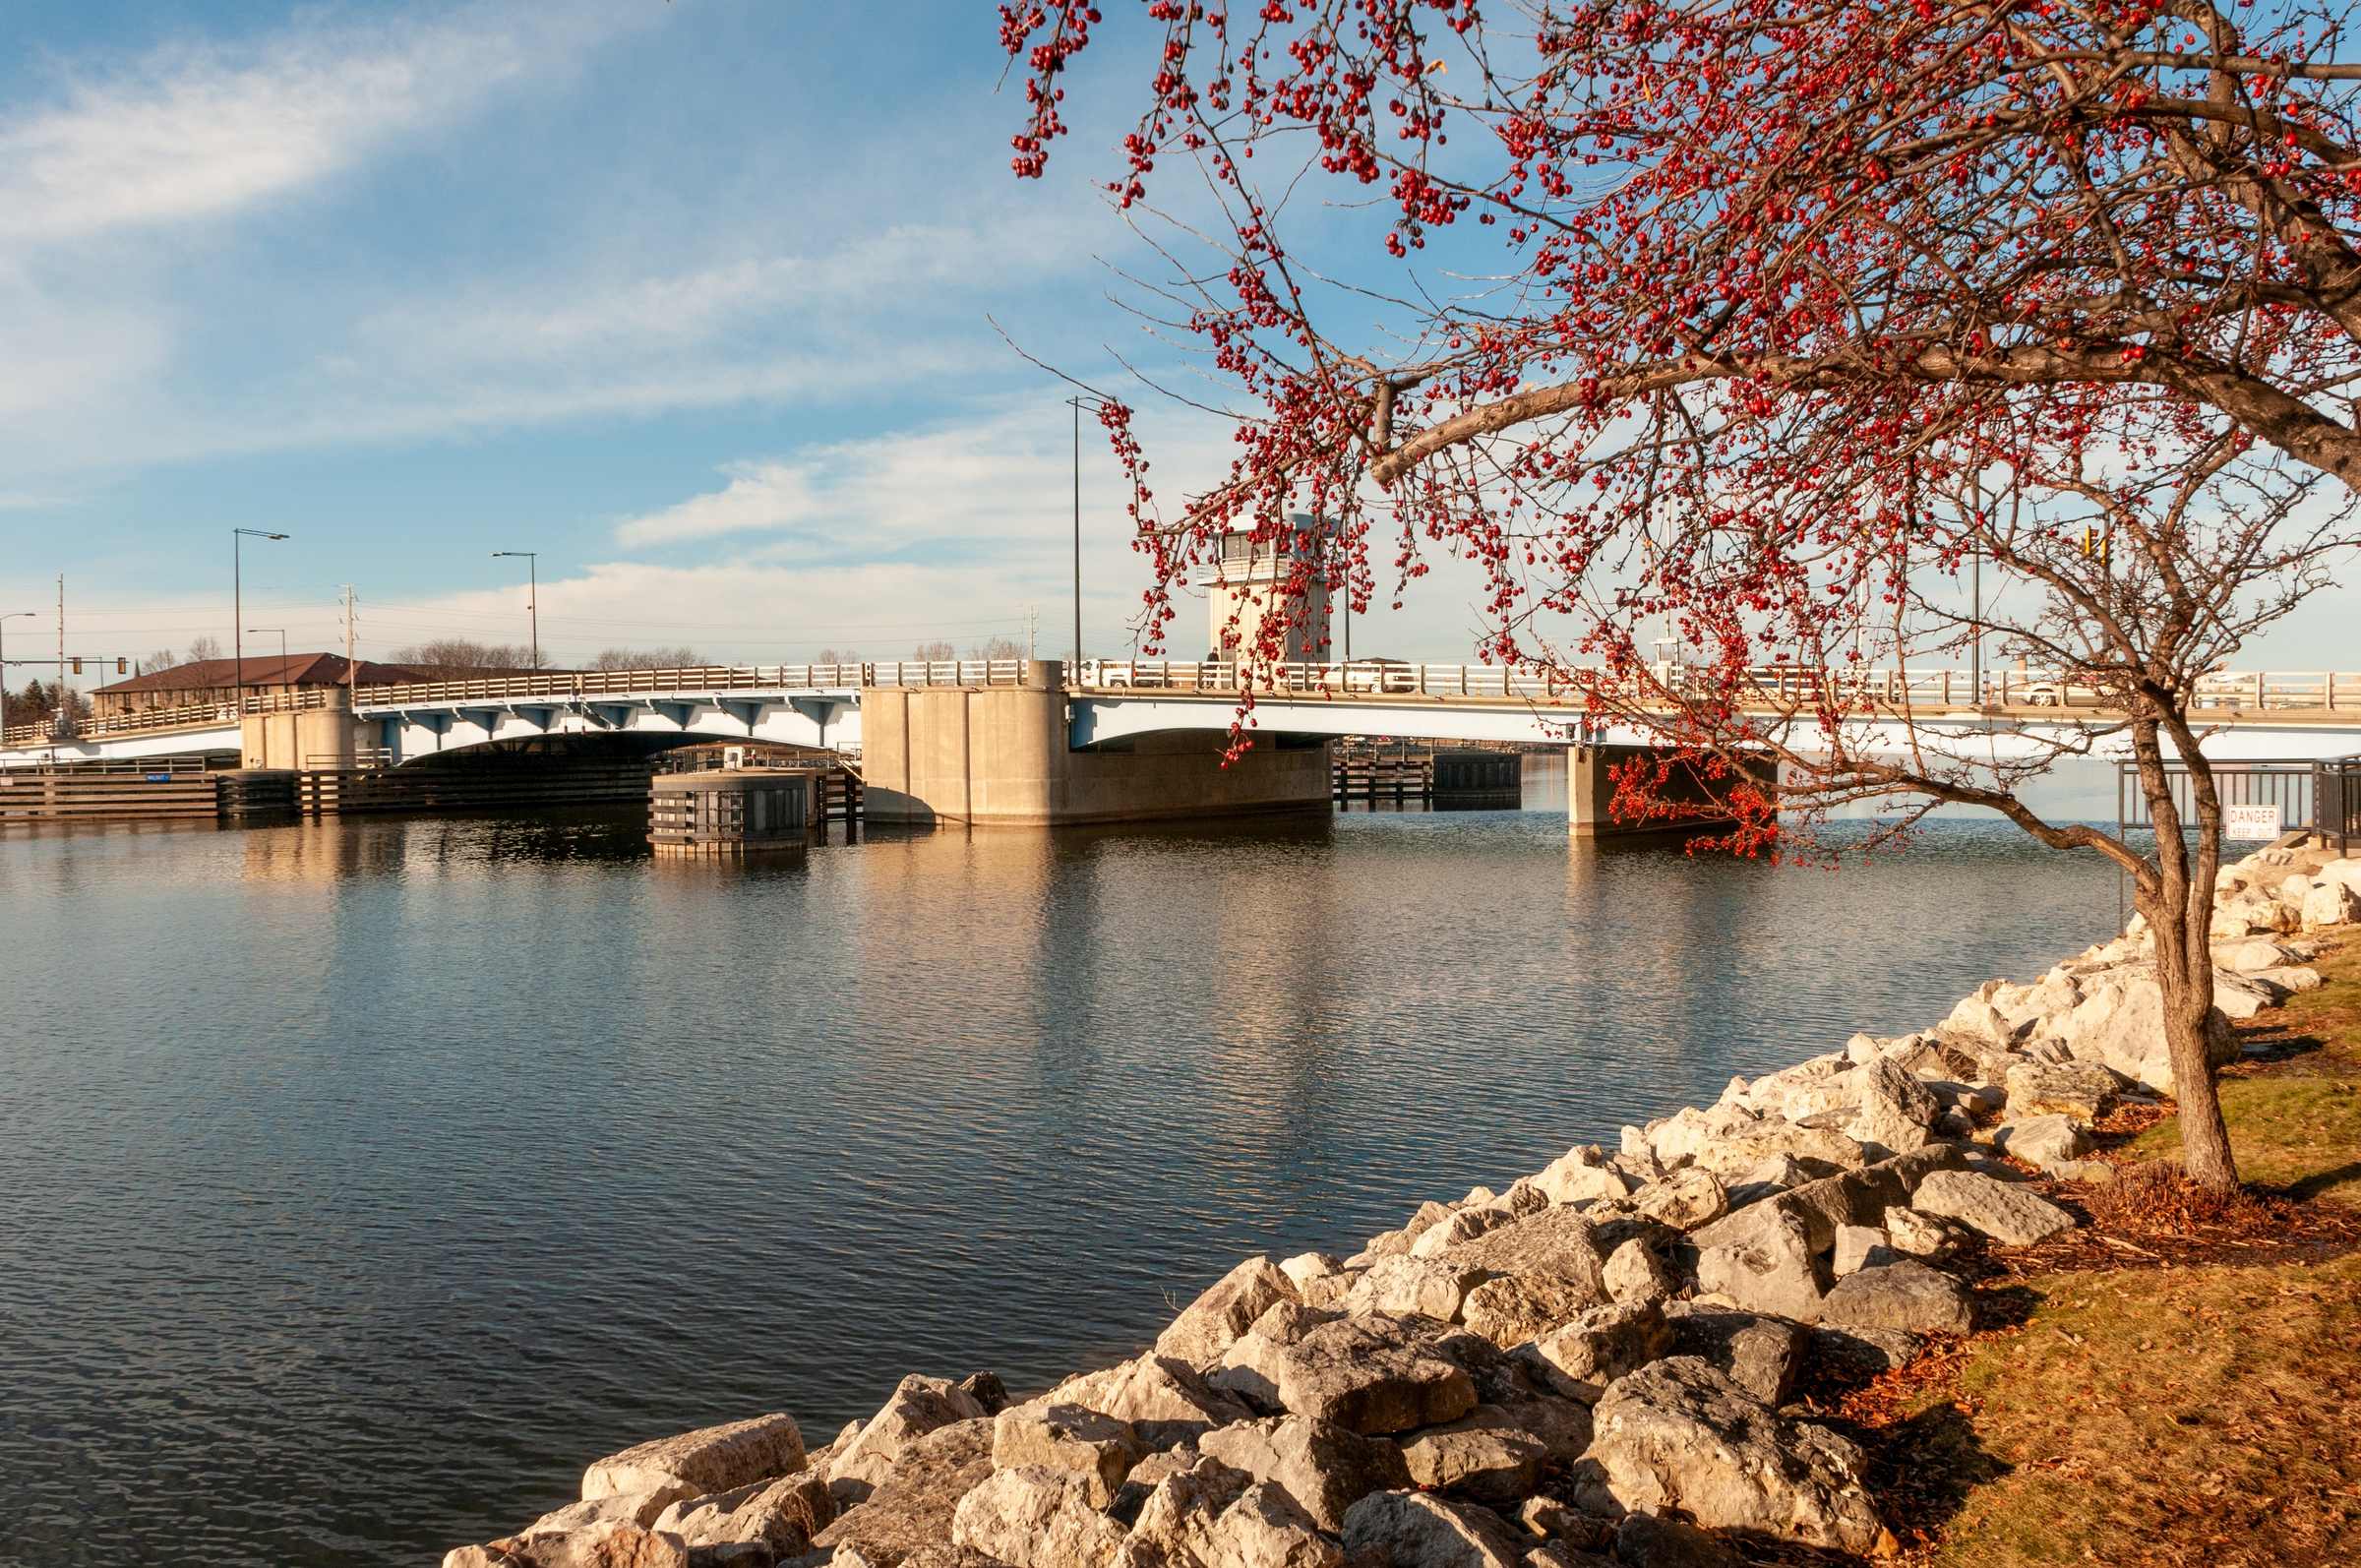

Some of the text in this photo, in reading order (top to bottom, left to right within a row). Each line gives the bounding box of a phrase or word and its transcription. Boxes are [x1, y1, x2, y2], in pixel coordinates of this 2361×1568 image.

[2230, 811, 2275, 823] DANGER
[2232, 828, 2272, 837] KEEP OUT
